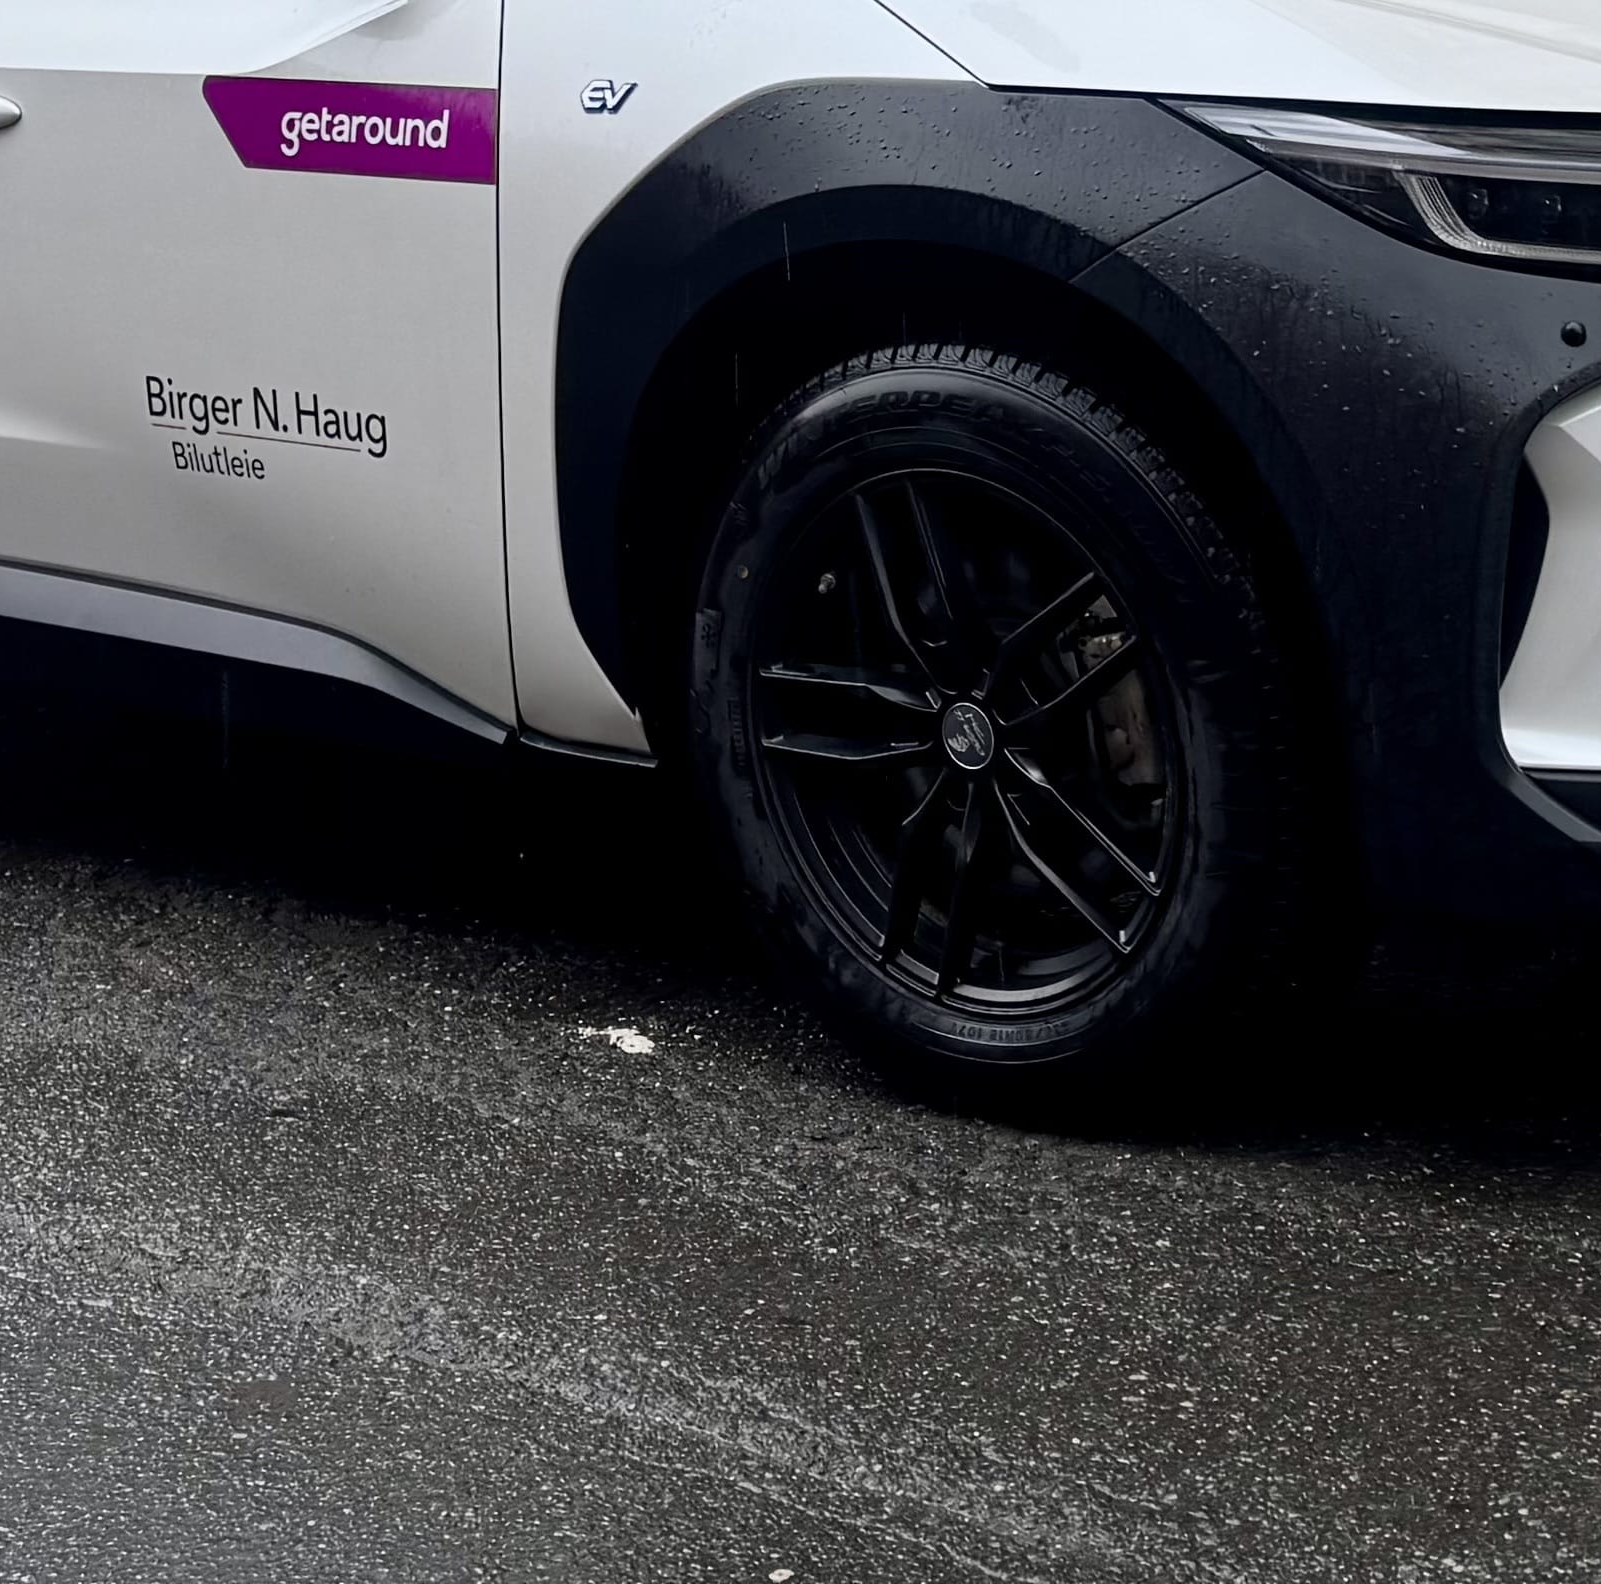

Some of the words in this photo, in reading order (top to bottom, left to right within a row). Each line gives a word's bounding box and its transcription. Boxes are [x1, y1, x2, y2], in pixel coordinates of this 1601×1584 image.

[579, 78, 638, 115] EV
[279, 106, 450, 156] getaround
[145, 375, 243, 435] Birger
[252, 386, 289, 434] N.
[294, 391, 388, 459] Haug
[171, 440, 266, 480] Bilutleie
